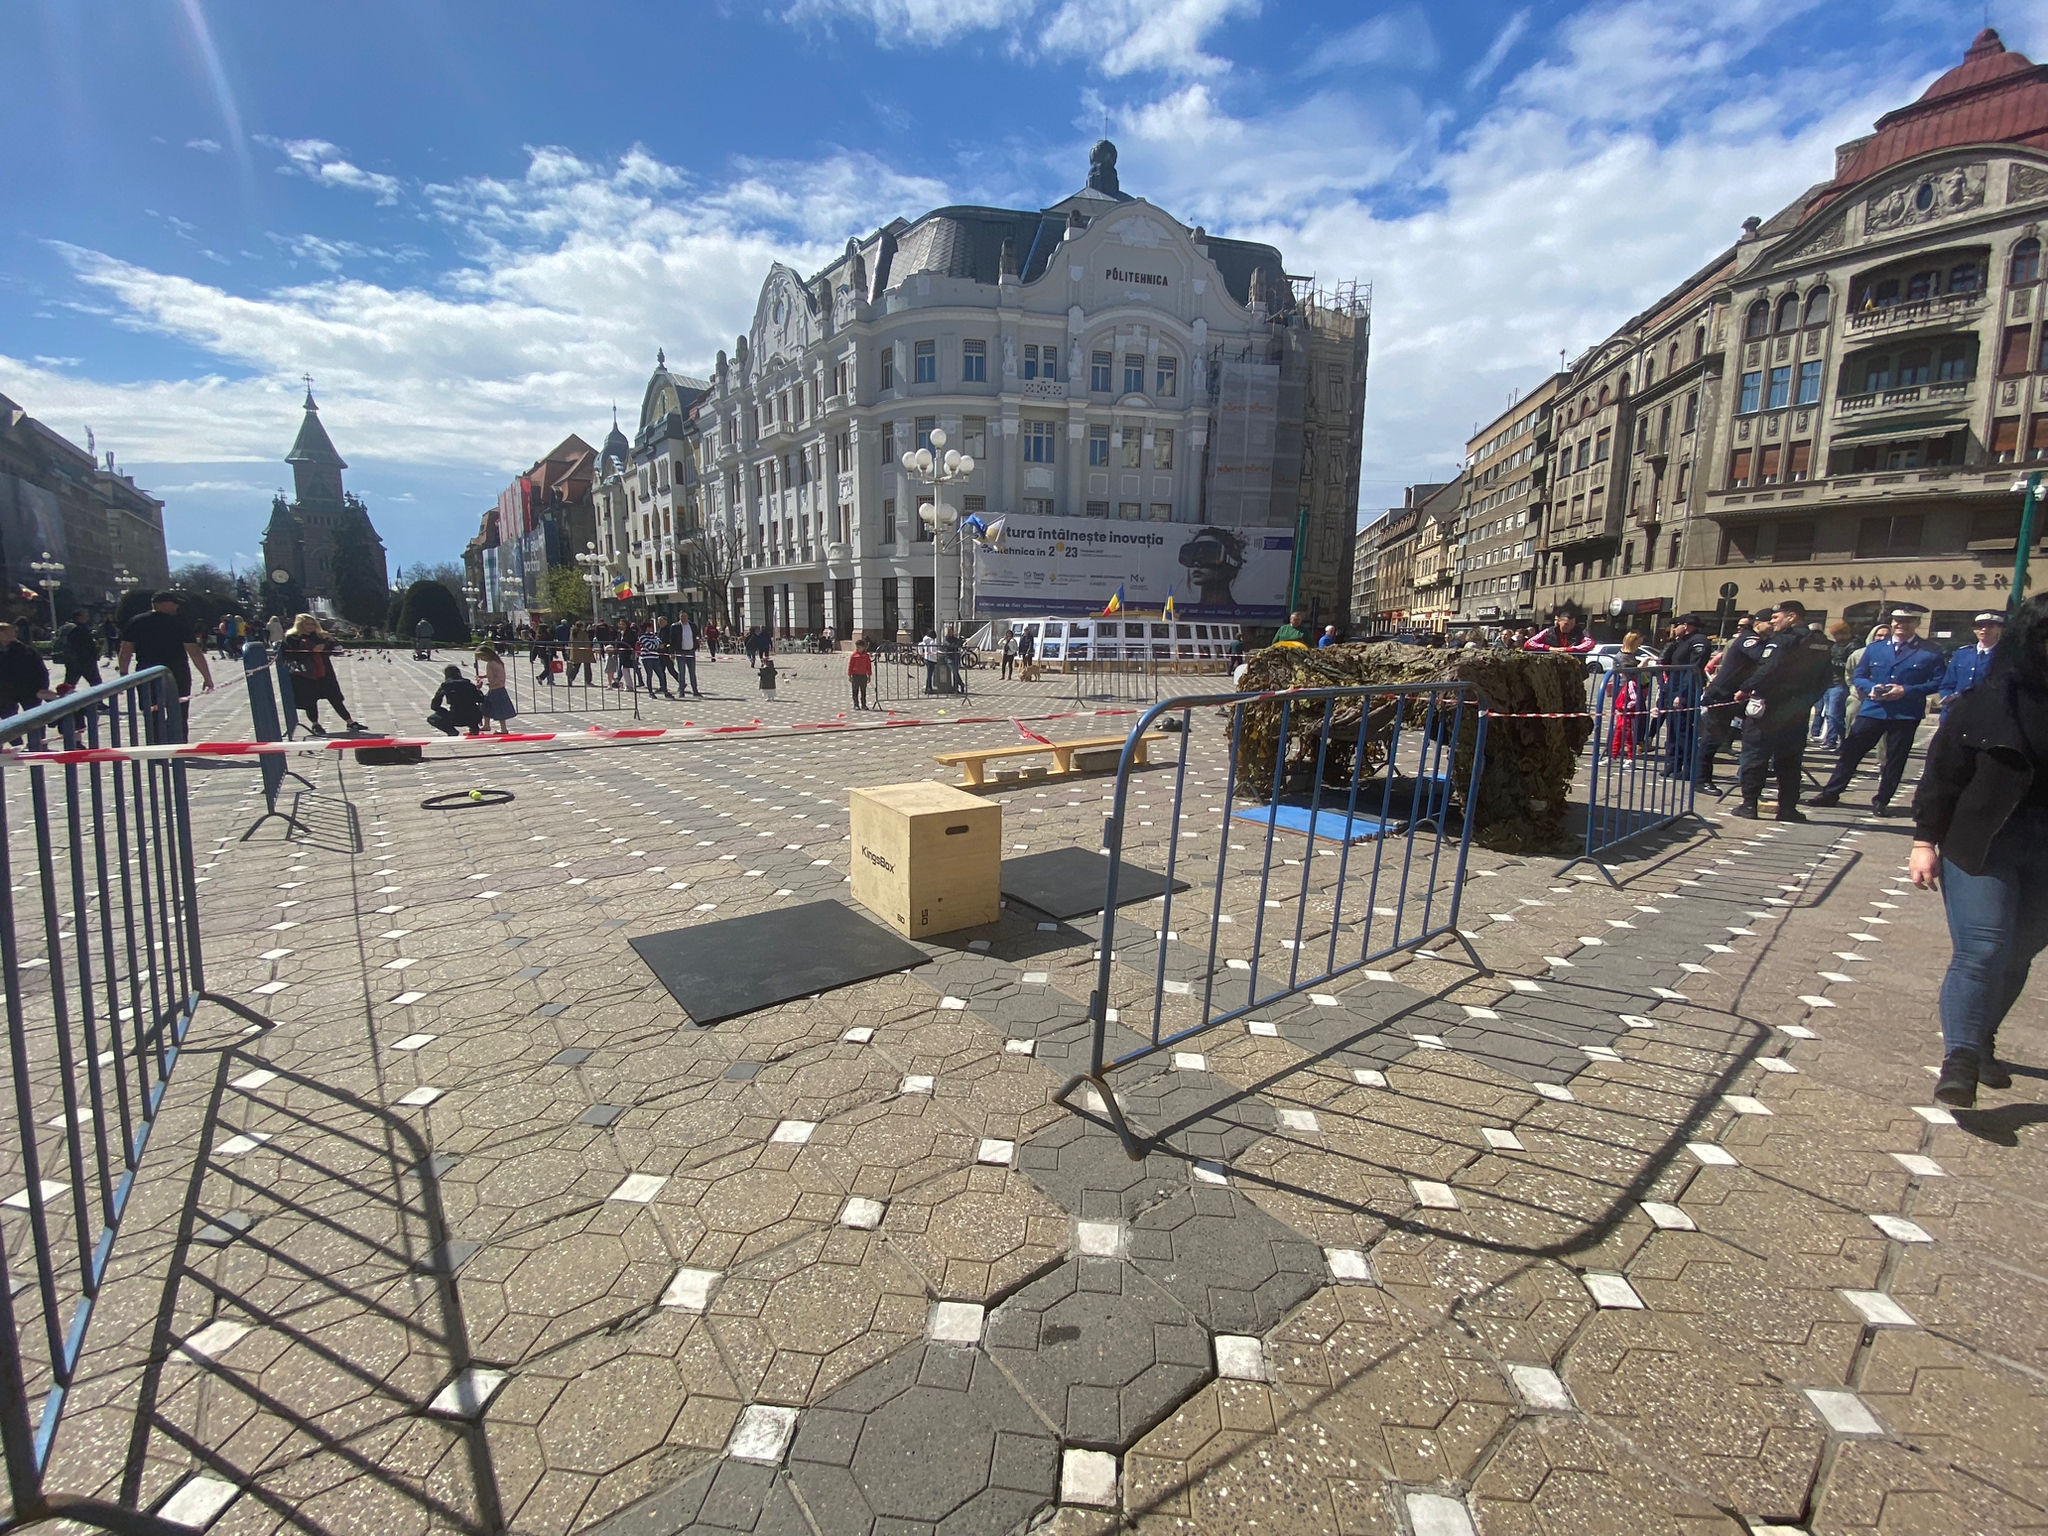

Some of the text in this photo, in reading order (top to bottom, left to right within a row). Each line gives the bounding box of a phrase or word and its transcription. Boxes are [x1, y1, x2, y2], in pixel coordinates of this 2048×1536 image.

[1105, 268, 1168, 286] POLITEHNICA
[1038, 527, 1106, 546] întâlnește
[1109, 531, 1163, 548] inovația
[1904, 573, 2031, 591] MODER
[861, 845, 895, 874] KingsBox
